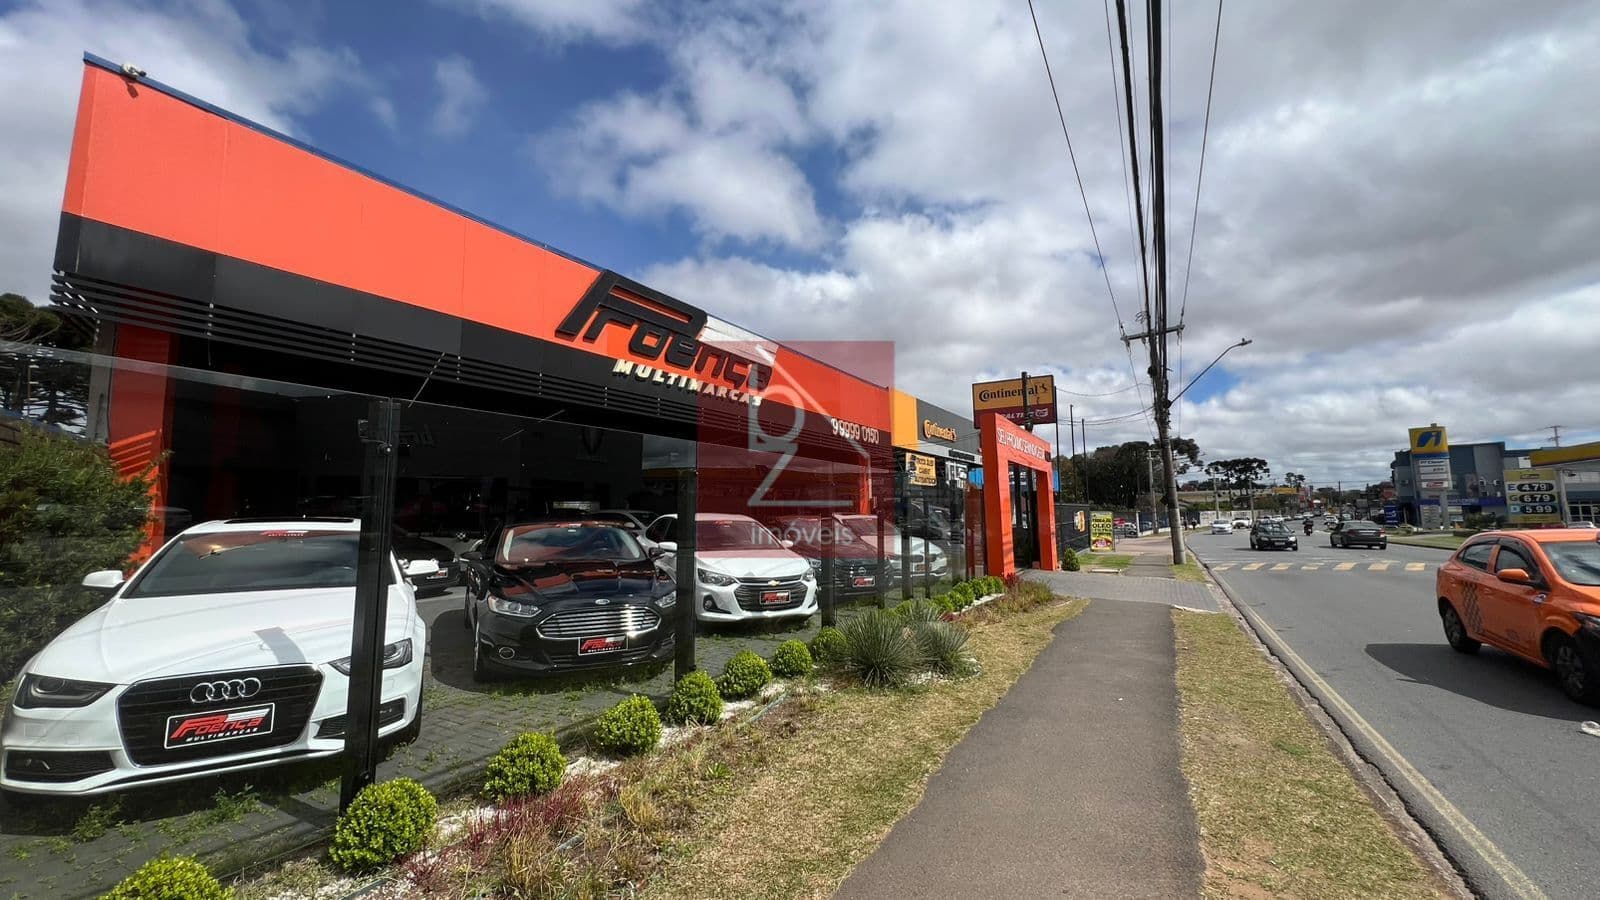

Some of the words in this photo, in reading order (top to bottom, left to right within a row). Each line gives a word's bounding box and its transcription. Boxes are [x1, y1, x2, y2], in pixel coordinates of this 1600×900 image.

[612, 359, 763, 407] MULTIMARCAS
[831, 418, 860, 441] 99999
[861, 426, 880, 445] 0150
[1525, 505, 1553, 513] 5.99
[185, 728, 258, 742] MULTIMARCAS
